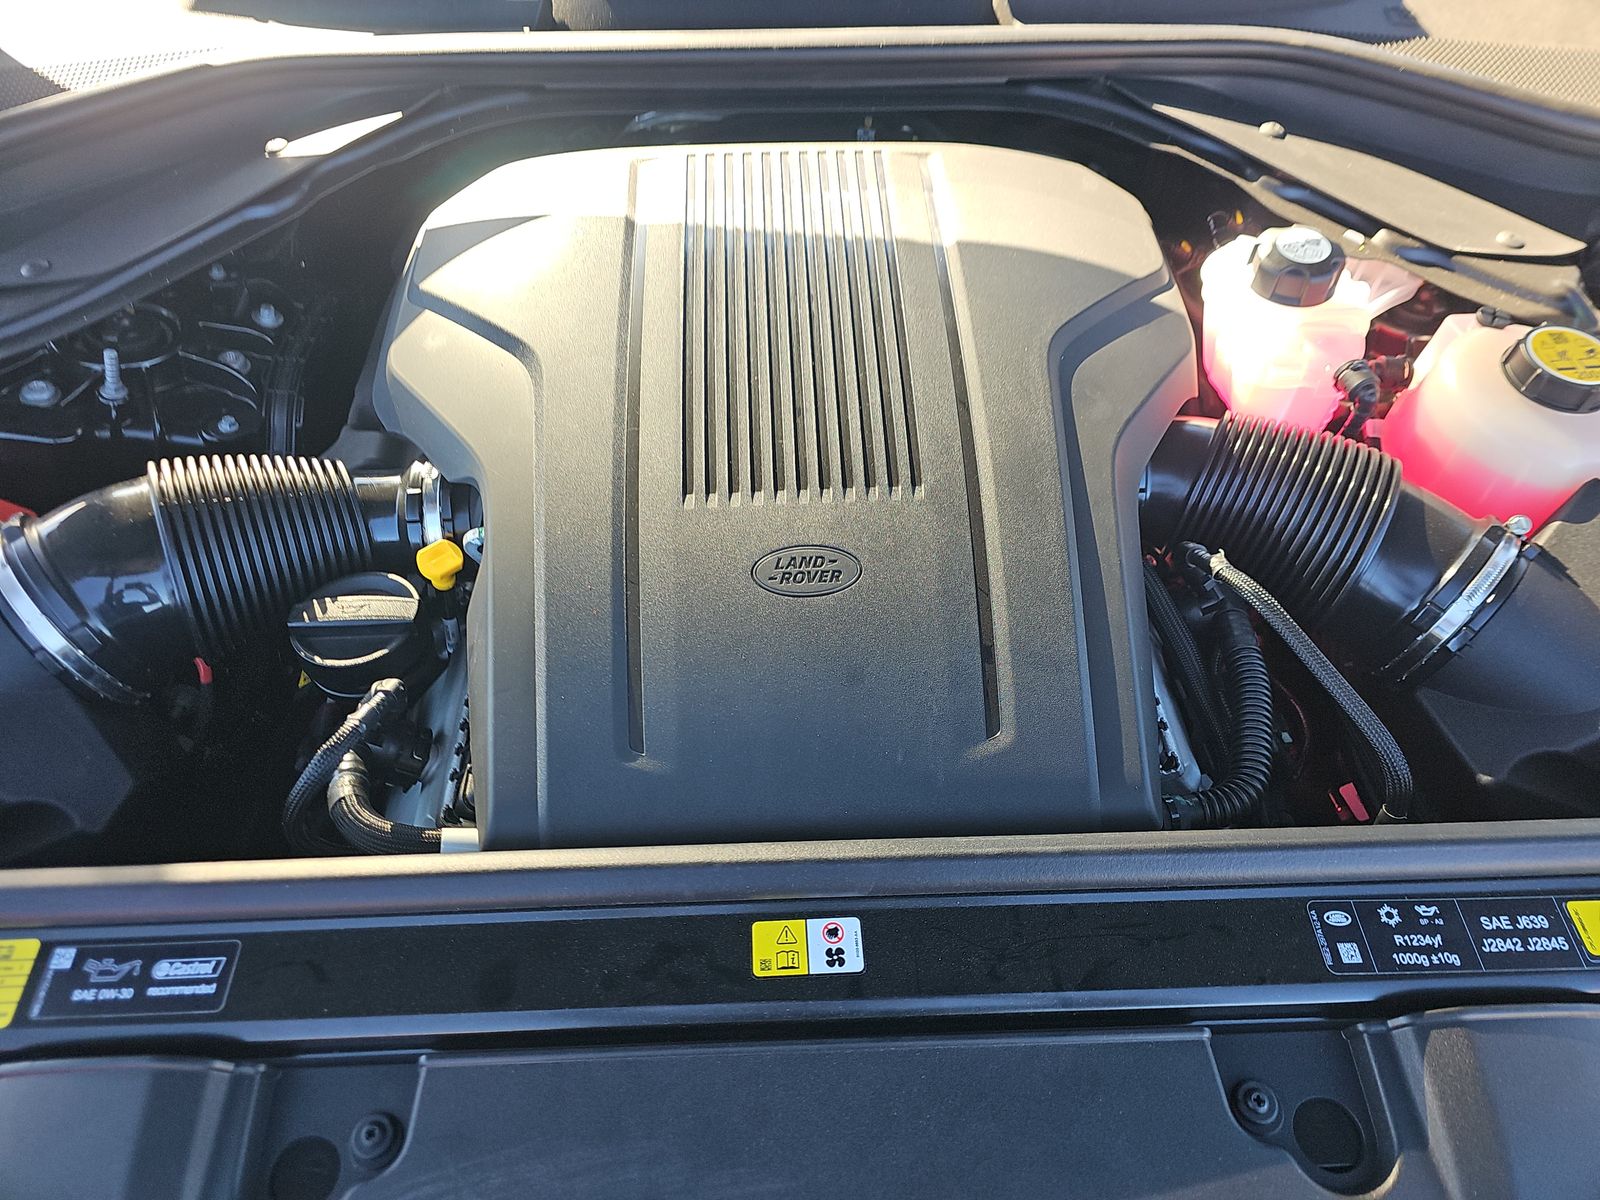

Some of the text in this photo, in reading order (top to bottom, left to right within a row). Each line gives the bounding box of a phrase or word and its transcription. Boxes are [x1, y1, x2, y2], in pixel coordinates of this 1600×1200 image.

[1480, 914, 1549, 930] SAE J639
[1393, 934, 1443, 948] R1234yf
[1482, 936, 1570, 953] J2842 J2845
[1392, 952, 1430, 967] 1000g
[169, 960, 217, 976] Castrol
[71, 988, 98, 1001] SAE
